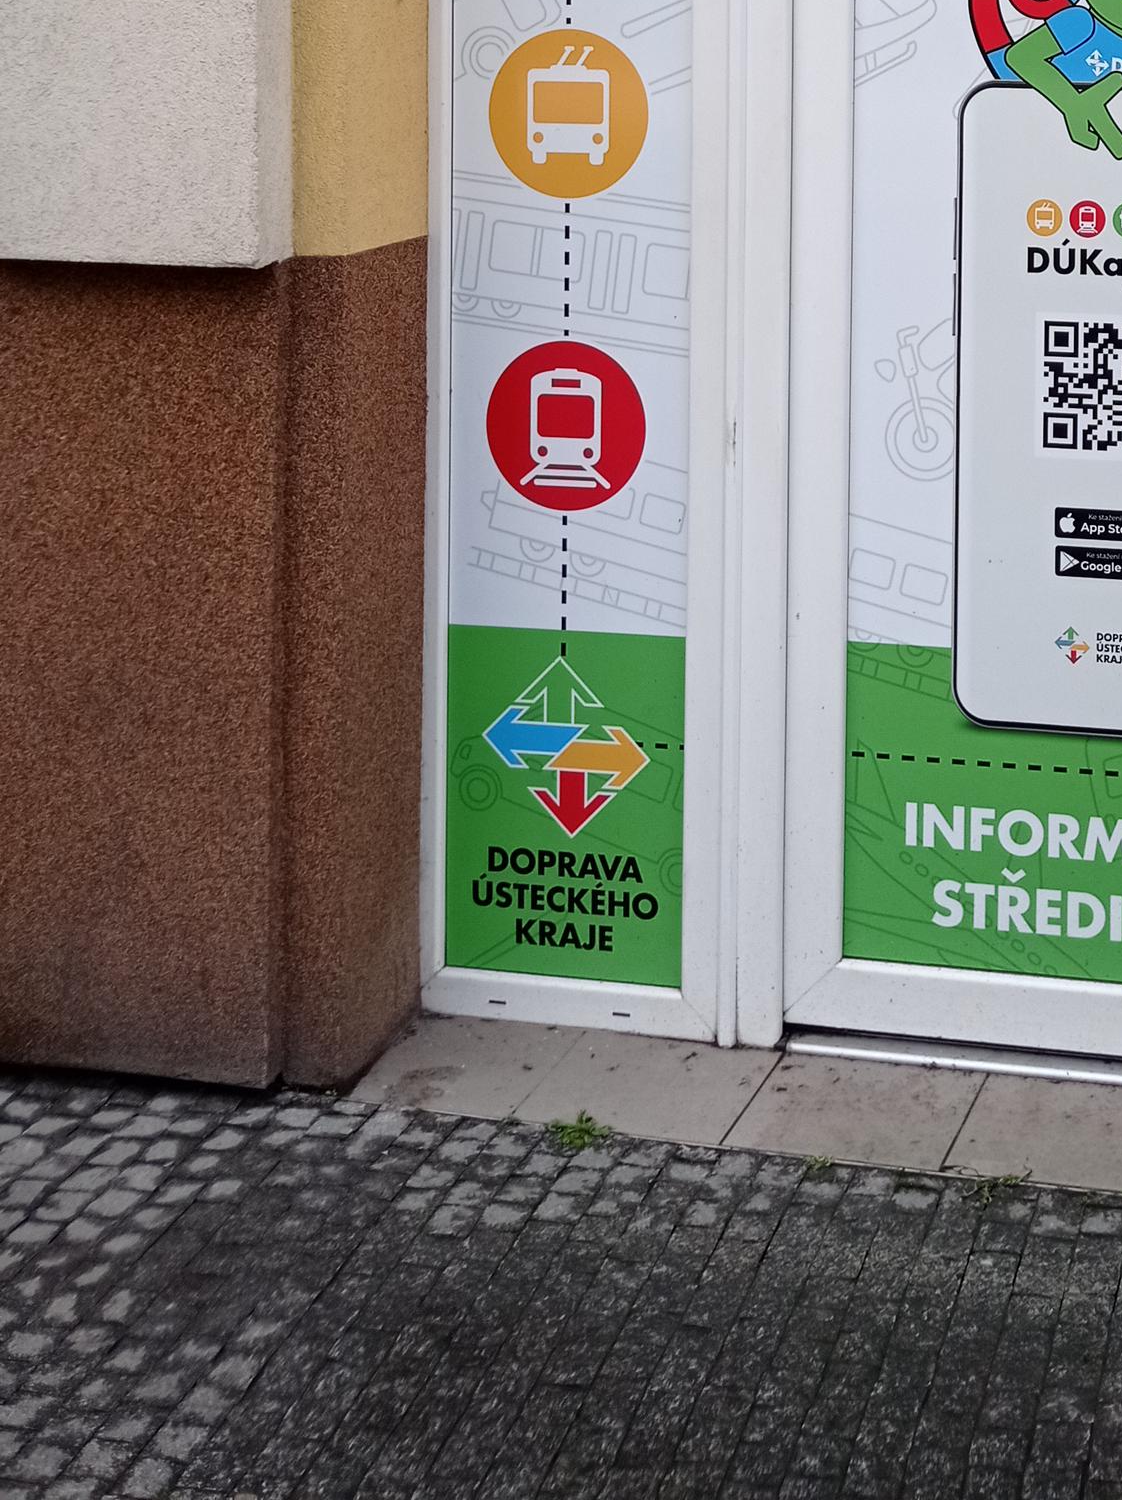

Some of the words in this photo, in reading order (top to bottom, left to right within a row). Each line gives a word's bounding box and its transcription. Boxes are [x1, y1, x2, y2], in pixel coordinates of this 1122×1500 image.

[1081, 522, 1105, 535] App
[1081, 561, 1122, 574] Google
[488, 846, 643, 883] DOPRAVA
[472, 873, 658, 920] ÚSTECKÉHO
[515, 918, 613, 952] KRAJE
